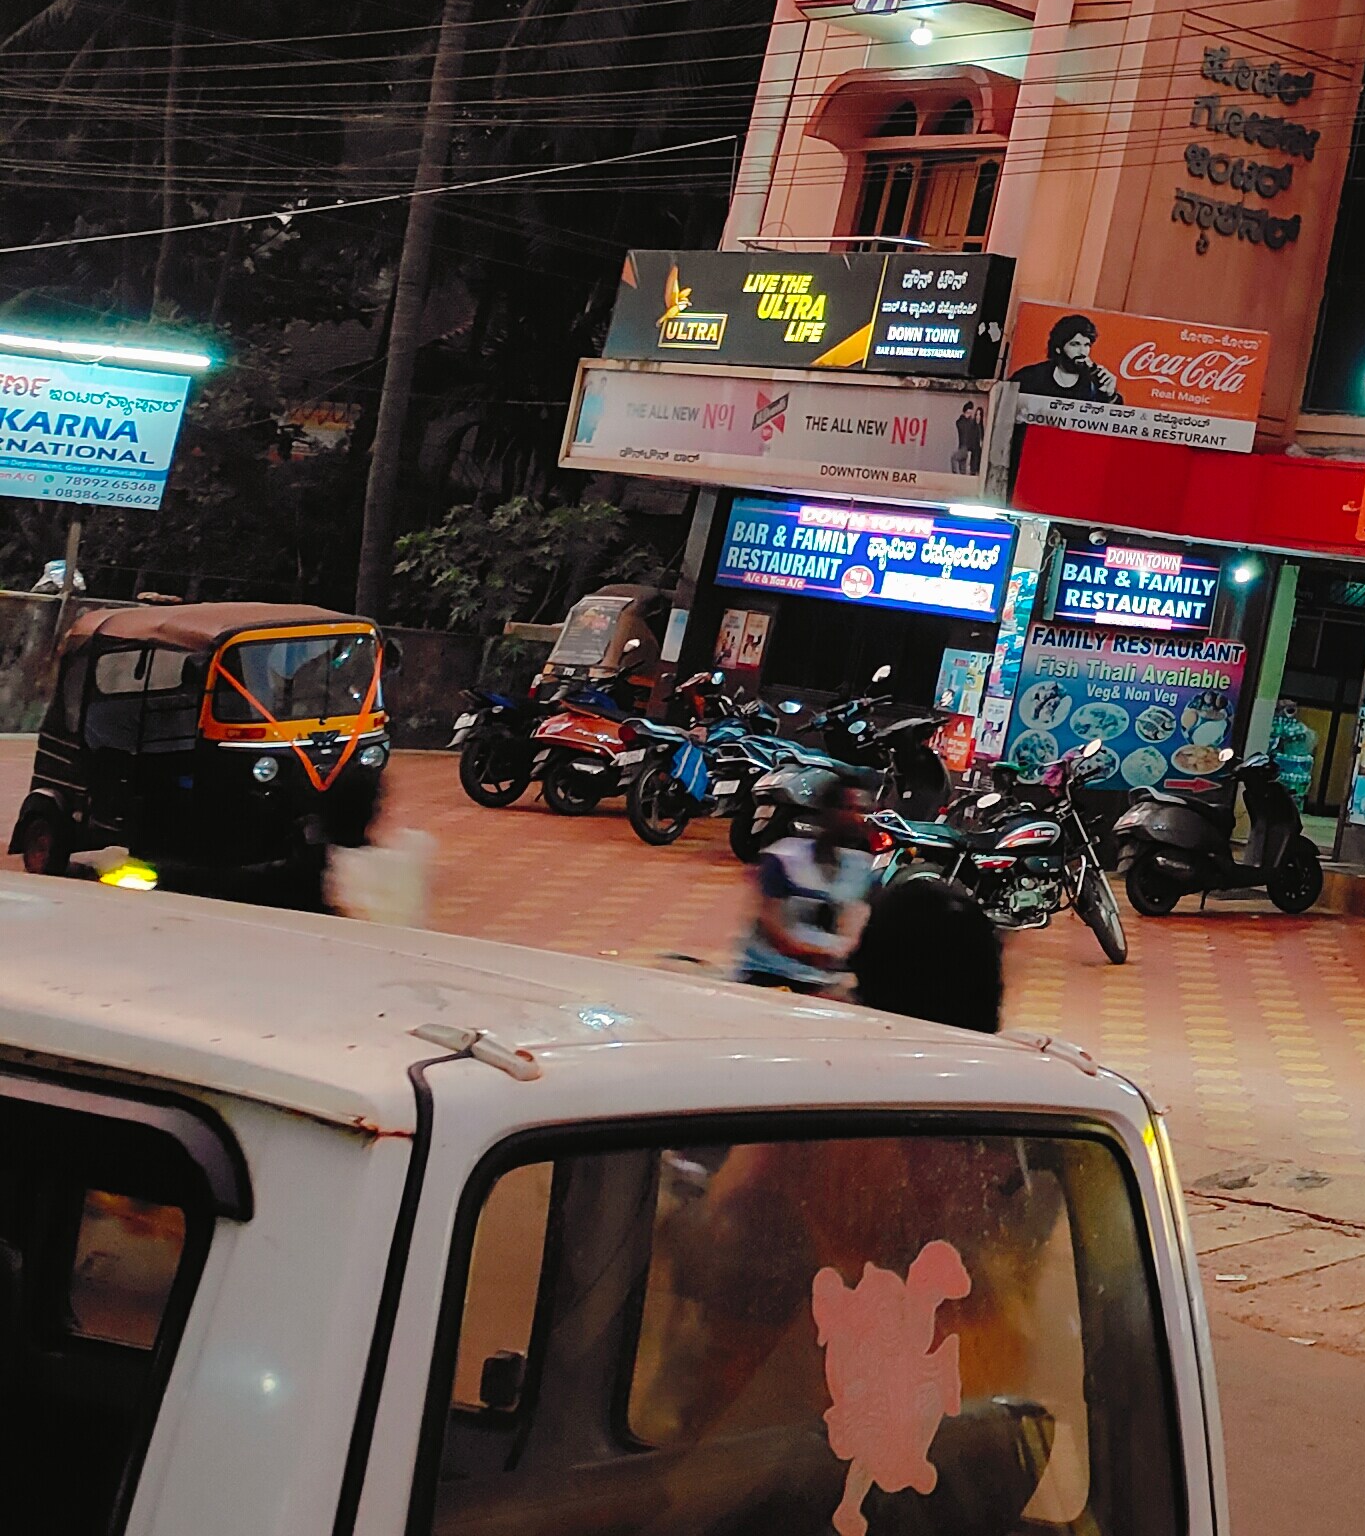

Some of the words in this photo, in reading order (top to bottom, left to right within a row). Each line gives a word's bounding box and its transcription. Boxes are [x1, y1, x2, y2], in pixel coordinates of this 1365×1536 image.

[742, 274, 781, 293] LIVE
[780, 275, 813, 293] THE
[757, 294, 826, 320] ULTRA
[666, 322, 718, 341] ULTRA
[784, 322, 826, 342] LIFE
[887, 326, 922, 342] DOWN
[924, 327, 960, 343] TOWN
[1119, 341, 1257, 393] Coca-Cola
[1151, 388, 1176, 402] Real
[1178, 390, 1211, 406] Magic
[648, 405, 670, 420] ALL
[672, 405, 700, 422] NEW
[805, 415, 828, 432] THE
[831, 416, 855, 434] ALL
[856, 418, 888, 437] NEW
[1027, 413, 1066, 427] DOWN
[1070, 418, 1109, 432] TOWN
[1112, 423, 1138, 435] BAR
[1141, 427, 1149, 437] &
[1152, 428, 1227, 447] RESTURANT
[820, 464, 890, 482] DOWNTOWN
[892, 470, 918, 484] BAR
[55, 488, 160, 505] 08386-256622
[801, 508, 866, 533] DOWN
[871, 515, 932, 536] TOWN
[732, 521, 767, 545] BAR
[772, 525, 788, 547] &
[791, 527, 861, 556] FAMILY
[725, 546, 843, 581] RESTAURANT
[1106, 550, 1144, 566] DOWN
[1146, 554, 1181, 571] TOWN
[744, 572, 760, 583] A/c
[761, 574, 769, 584] &
[770, 575, 786, 586] Non
[787, 577, 804, 589] A/c
[1062, 563, 1108, 585] BAR
[1114, 570, 1131, 587] &
[1139, 573, 1216, 597] FAMILY
[1065, 588, 1206, 620] RESTAURANT
[1032, 627, 1108, 651] FAMILY
[1113, 635, 1245, 664] RESTAURANT
[1035, 655, 1078, 679] Fish
[1087, 660, 1137, 684] Thali
[1141, 664, 1231, 690] Available
[1087, 683, 1120, 701] Veg&
[1124, 686, 1150, 702] Non
[1154, 689, 1178, 707] Veg
